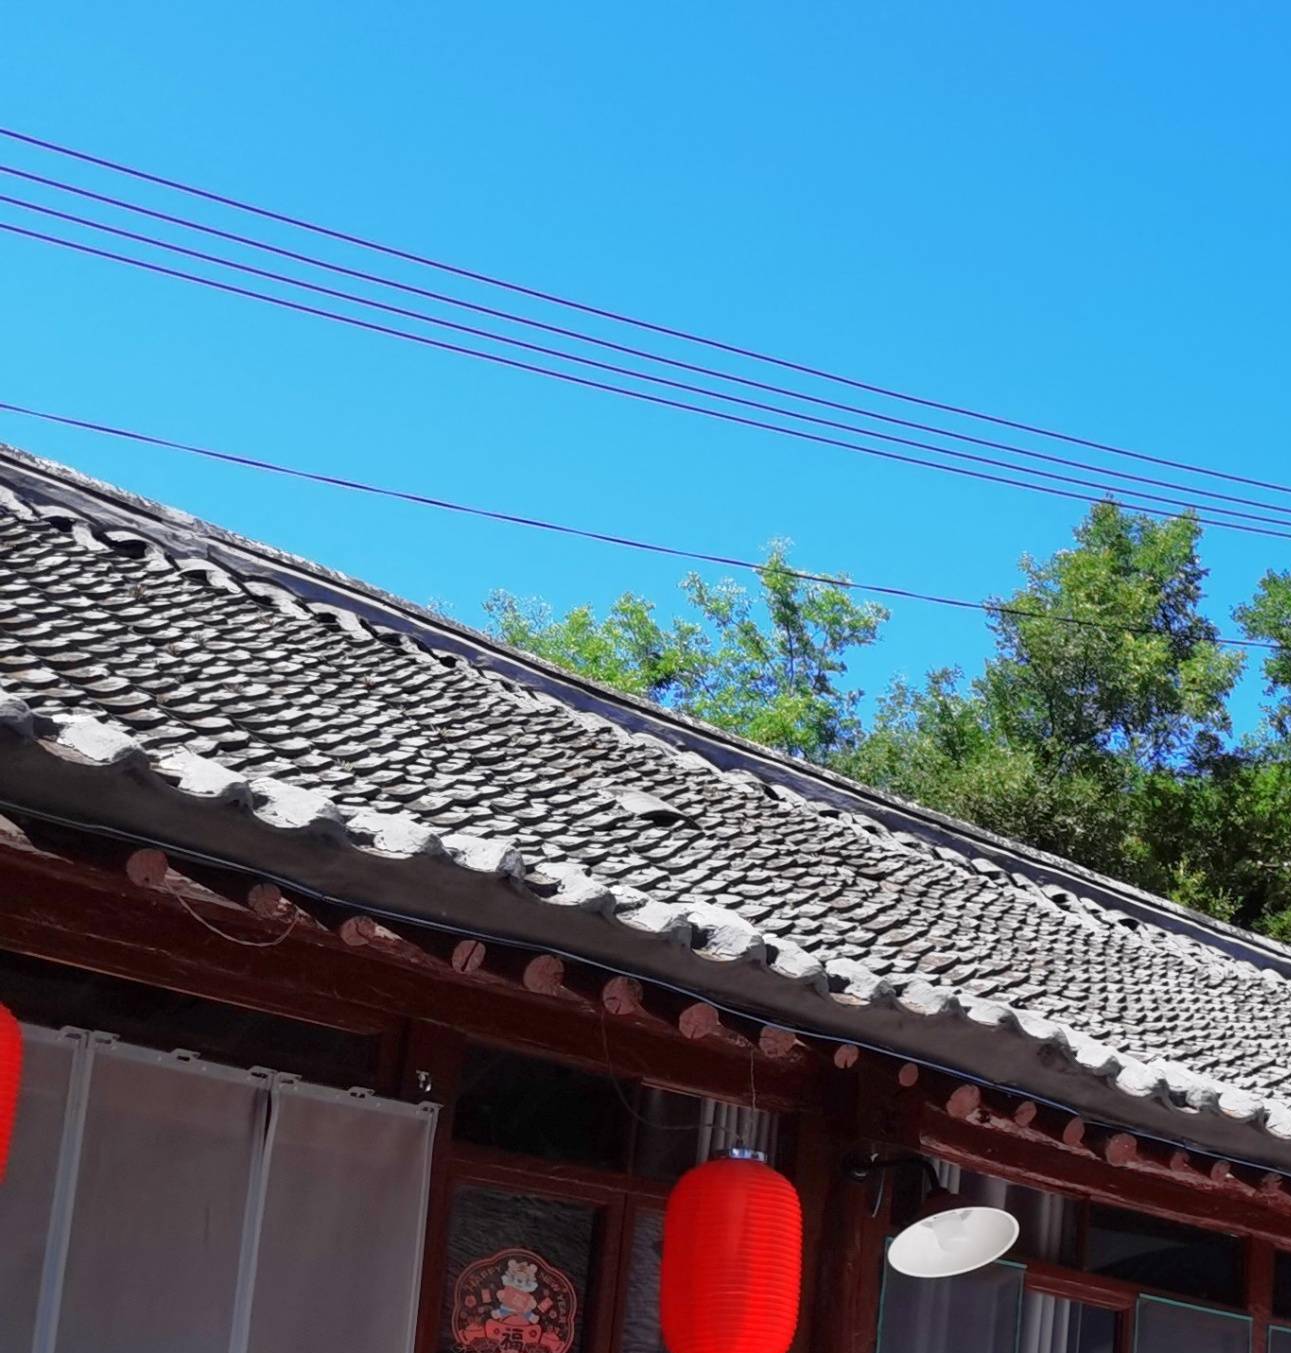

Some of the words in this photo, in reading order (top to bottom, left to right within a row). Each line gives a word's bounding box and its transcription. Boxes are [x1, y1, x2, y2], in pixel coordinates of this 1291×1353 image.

[463, 1265, 501, 1292] HAPPY
[538, 1271, 561, 1291] NEW
[556, 1294, 566, 1323] YEAR
[500, 1327, 524, 1352] 福
